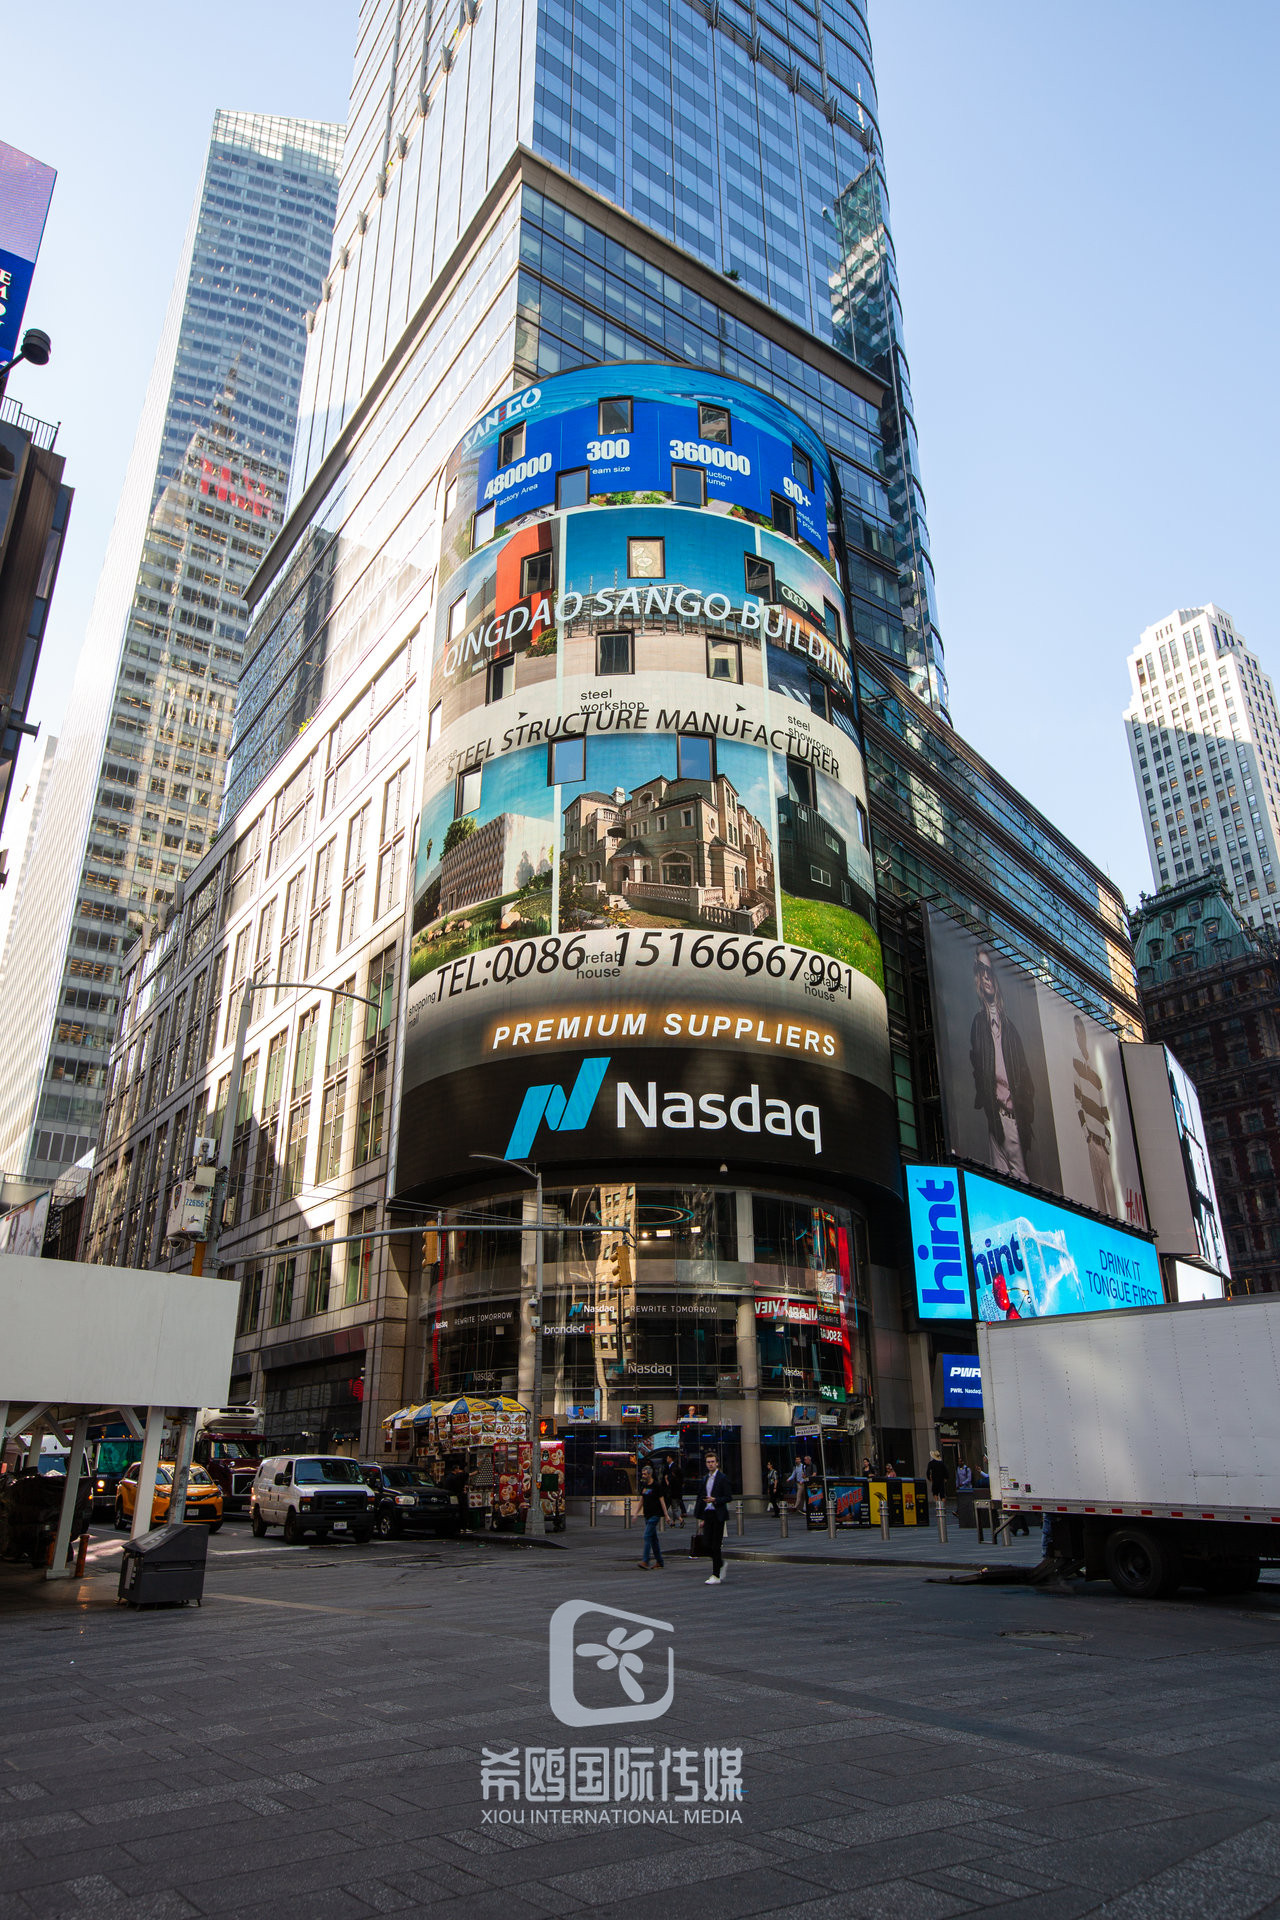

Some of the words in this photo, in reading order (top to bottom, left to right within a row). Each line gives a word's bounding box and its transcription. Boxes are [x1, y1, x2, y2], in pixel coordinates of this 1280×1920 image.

[586, 438, 631, 461] 300
[669, 439, 751, 476] 360000
[484, 452, 553, 500] 480000
[590, 467, 612, 475] eam
[613, 465, 631, 473] size
[705, 476, 726, 487] lume
[521, 483, 539, 495] Area
[783, 476, 812, 508] 90+
[443, 591, 583, 678] QINGDAO
[591, 586, 731, 620] SANGO
[741, 600, 854, 697] BUILDING
[580, 688, 612, 700] steel
[580, 699, 645, 713] workshop
[787, 715, 811, 732] steel
[446, 737, 495, 780] STEEL
[500, 708, 650, 752] STRUCTURE
[655, 708, 840, 779] MANUFACTURER
[788, 727, 834, 757] showroom
[577, 950, 622, 967] refab
[615, 931, 853, 1001] 15166667991
[576, 967, 621, 979] house
[408, 991, 436, 1017] shopping
[804, 983, 836, 1003] house
[492, 1013, 647, 1050] PREMIUM
[663, 1012, 836, 1057] SUPPLIERS
[616, 1081, 822, 1155] Nasdaq
[917, 1179, 966, 1305] hint
[972, 1233, 1024, 1290] hint
[1099, 1249, 1132, 1280] DRINK
[1131, 1260, 1141, 1282] IT
[1085, 1270, 1132, 1303] TONGUE
[1131, 1284, 1158, 1306] FIRST
[477, 1311, 513, 1322] TOMORROW
[583, 1304, 615, 1314] Nasdaq
[630, 1305, 667, 1314] REWRITE
[670, 1305, 718, 1314] TOMORROW
[628, 1362, 672, 1377] Nasdaq
